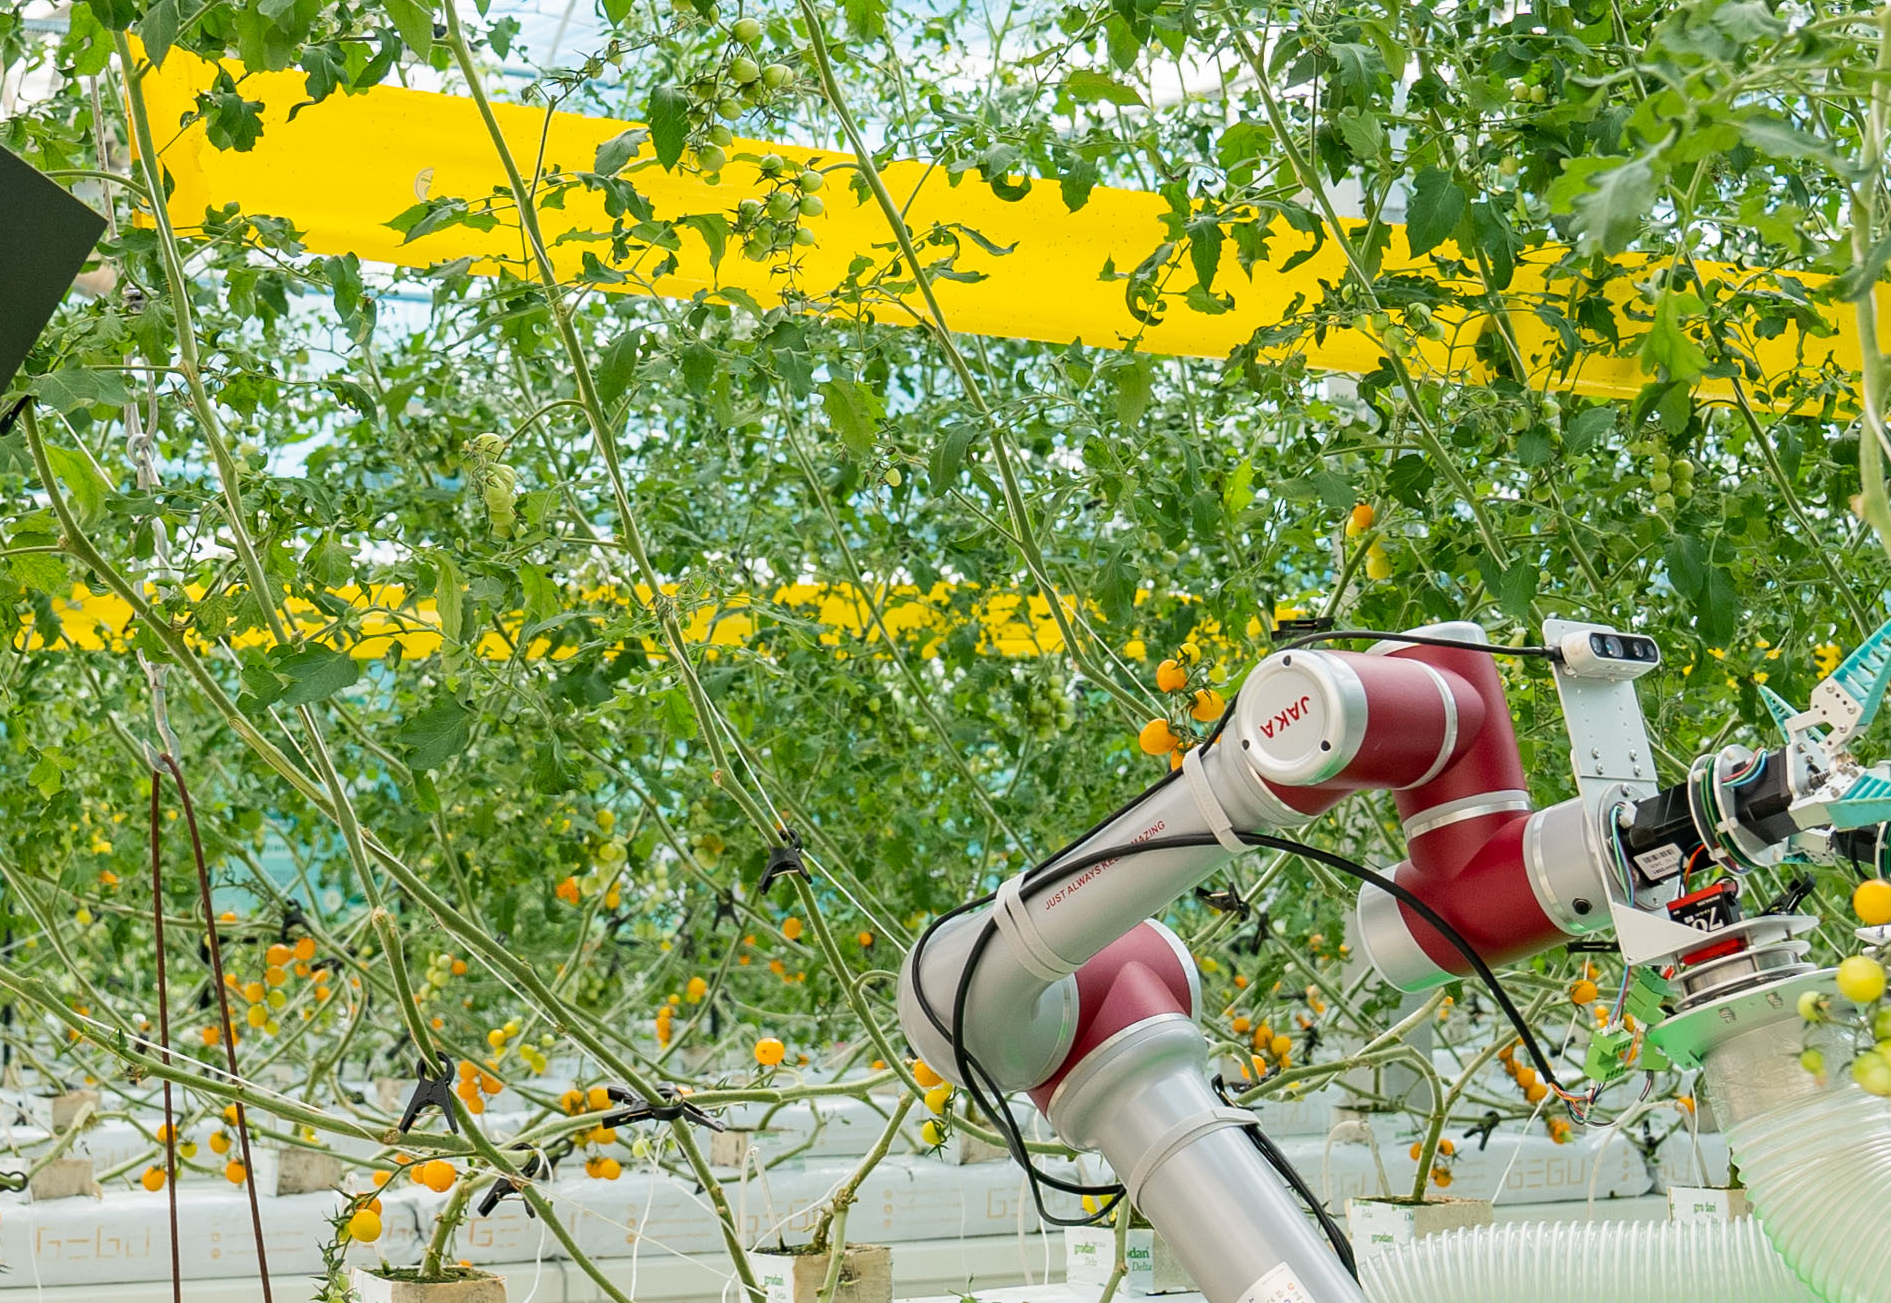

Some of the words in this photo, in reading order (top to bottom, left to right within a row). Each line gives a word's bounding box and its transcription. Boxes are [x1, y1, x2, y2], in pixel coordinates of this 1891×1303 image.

[1259, 696, 1310, 739] JAKA
[1045, 889, 1067, 911] JUST
[1067, 865, 1102, 895] ALWAYS
[1506, 1157, 1586, 1190] GEGU
